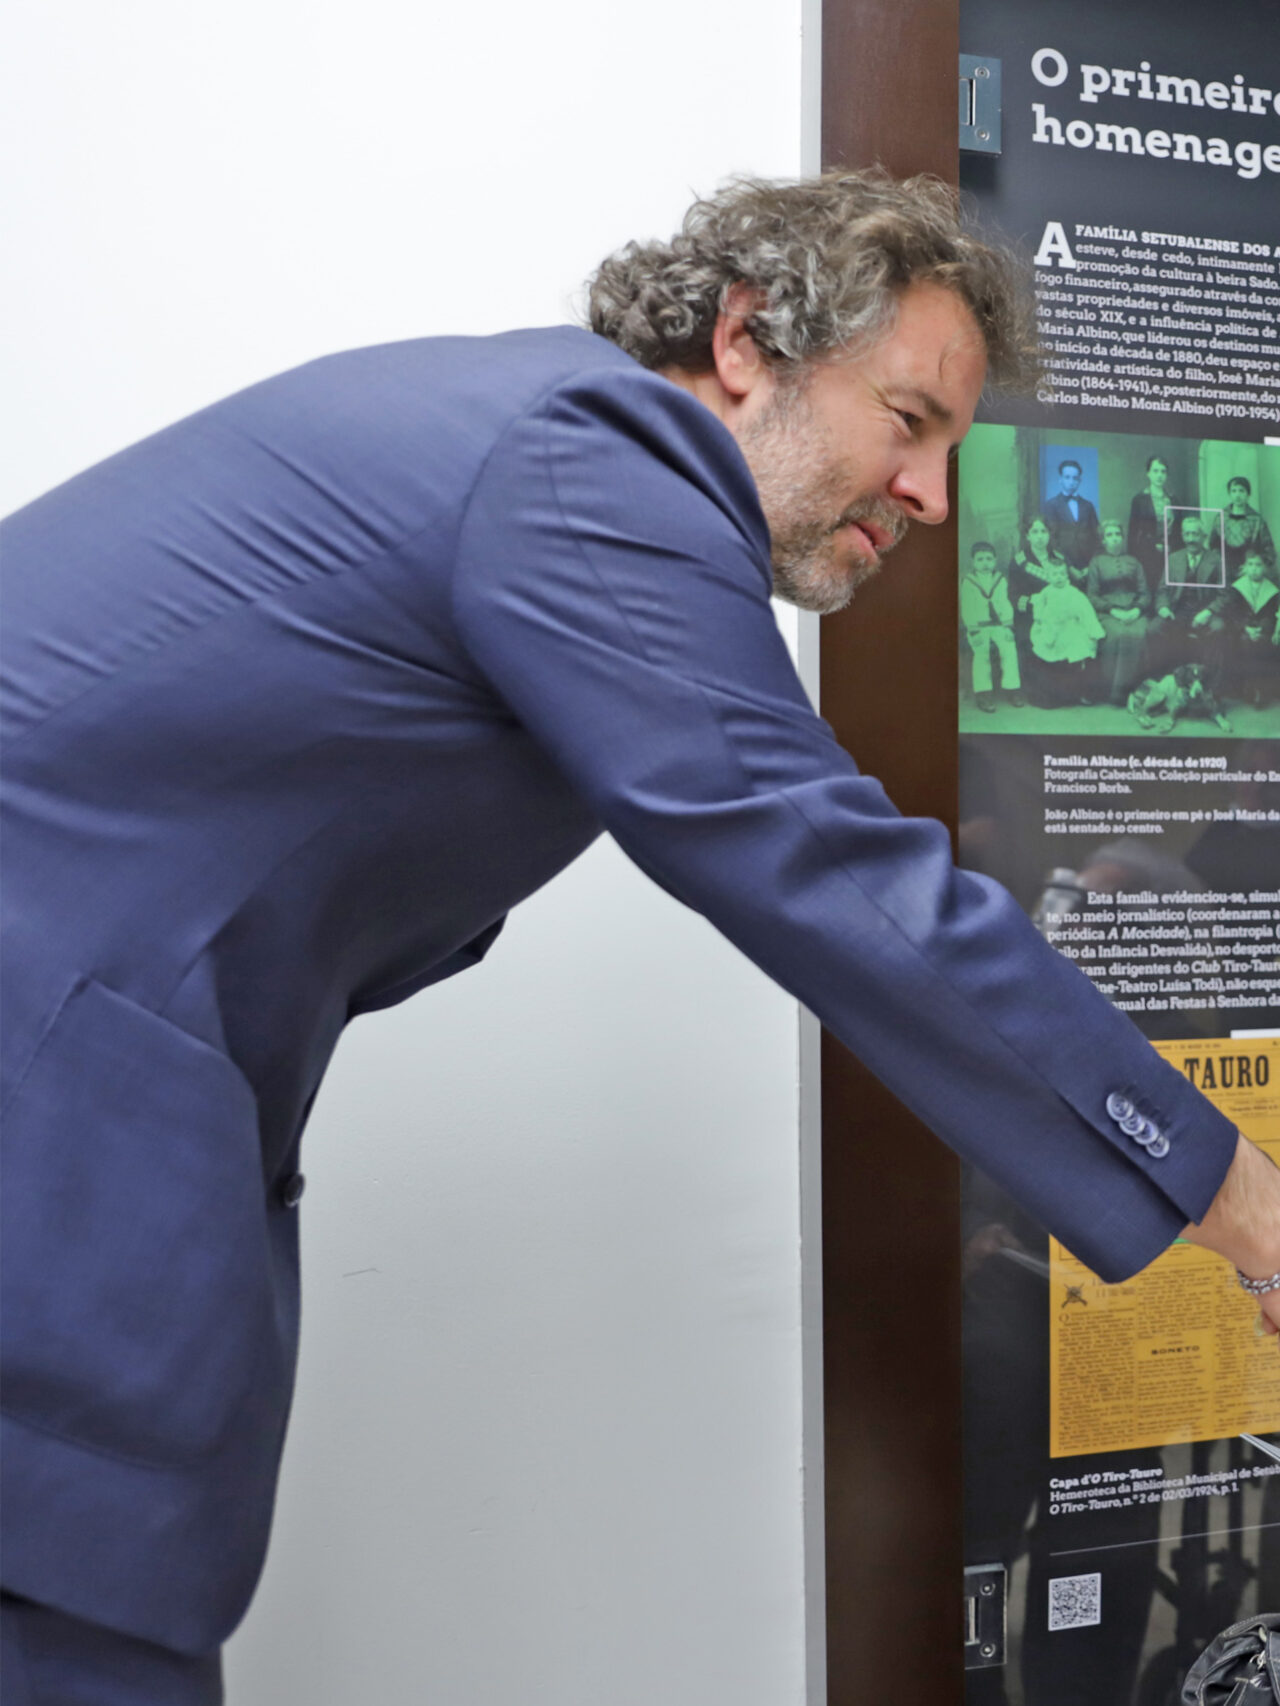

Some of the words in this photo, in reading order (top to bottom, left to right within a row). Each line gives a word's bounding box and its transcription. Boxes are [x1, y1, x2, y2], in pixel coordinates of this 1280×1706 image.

[1031, 47, 1068, 87] O
[1033, 221, 1076, 269] A
[1075, 222, 1137, 241] FAMÍLIA
[1141, 229, 1239, 252] SETUBALENSE
[1242, 240, 1270, 256] DOS
[1075, 242, 1118, 259] esteve,
[1121, 245, 1158, 261] desde
[1161, 250, 1194, 267] cedo,
[1197, 253, 1275, 273] intimamente
[1034, 269, 1063, 287] fogo
[1064, 272, 1132, 294] financeiro,
[1132, 282, 1202, 298] assegurado
[1203, 287, 1247, 303] através
[1247, 291, 1263, 304] da
[1076, 260, 1139, 277] promoção
[1141, 263, 1157, 277] da
[1158, 267, 1203, 282] cultura
[1205, 270, 1213, 283] à
[1215, 271, 1247, 286] beira
[1248, 274, 1280, 290] Sado.
[1034, 289, 1073, 302] vastas
[1076, 293, 1159, 311] propriedades
[1161, 302, 1169, 312] e
[1171, 300, 1223, 317] diversos
[1225, 305, 1275, 324] imóveis,
[1089, 755, 1128, 766] Albino
[1142, 756, 1183, 767] década
[1184, 757, 1198, 767] de
[1044, 769, 1098, 782] Fotografia
[1099, 769, 1157, 780] Cabecinha.
[1158, 769, 1201, 782] Coleção
[1201, 770, 1252, 783] particular
[1253, 770, 1267, 780] do
[1044, 782, 1097, 792] Francisco
[1098, 782, 1132, 793] Borba.
[1044, 822, 1067, 833] está
[1068, 822, 1111, 832] sentado
[1112, 824, 1125, 832] ao
[1126, 822, 1163, 832] centro.
[1087, 891, 1113, 904] Esta
[1116, 891, 1158, 903] família
[1161, 890, 1247, 904] evidenciou-se,
[1062, 913, 1080, 922] no
[1082, 910, 1115, 922] meio
[1116, 908, 1185, 925] jornalístico
[1186, 907, 1271, 924] (coordenaram
[1272, 910, 1280, 919] a
[1045, 927, 1105, 944] periódica
[1107, 927, 1118, 939] A
[1121, 925, 1192, 941] Mocidade),
[1193, 928, 1209, 938] na
[1212, 925, 1273, 940] filantropia
[1184, 1055, 1270, 1090] TAURO
[1049, 1477, 1079, 1488] Capa
[1080, 1472, 1101, 1484] d'O
[1102, 1468, 1163, 1481] Tiro-Tauro
[1050, 1486, 1116, 1501] Hemeroteca
[1117, 1482, 1130, 1493] da
[1132, 1478, 1184, 1491] Biblioteca
[1184, 1468, 1237, 1484] Municipal
[1238, 1468, 1251, 1478] de
[1049, 1503, 1060, 1514] O
[1060, 1498, 1122, 1512] Tiro-Tauro,
[1139, 1492, 1146, 1503] 2
[1146, 1491, 1160, 1502] de
